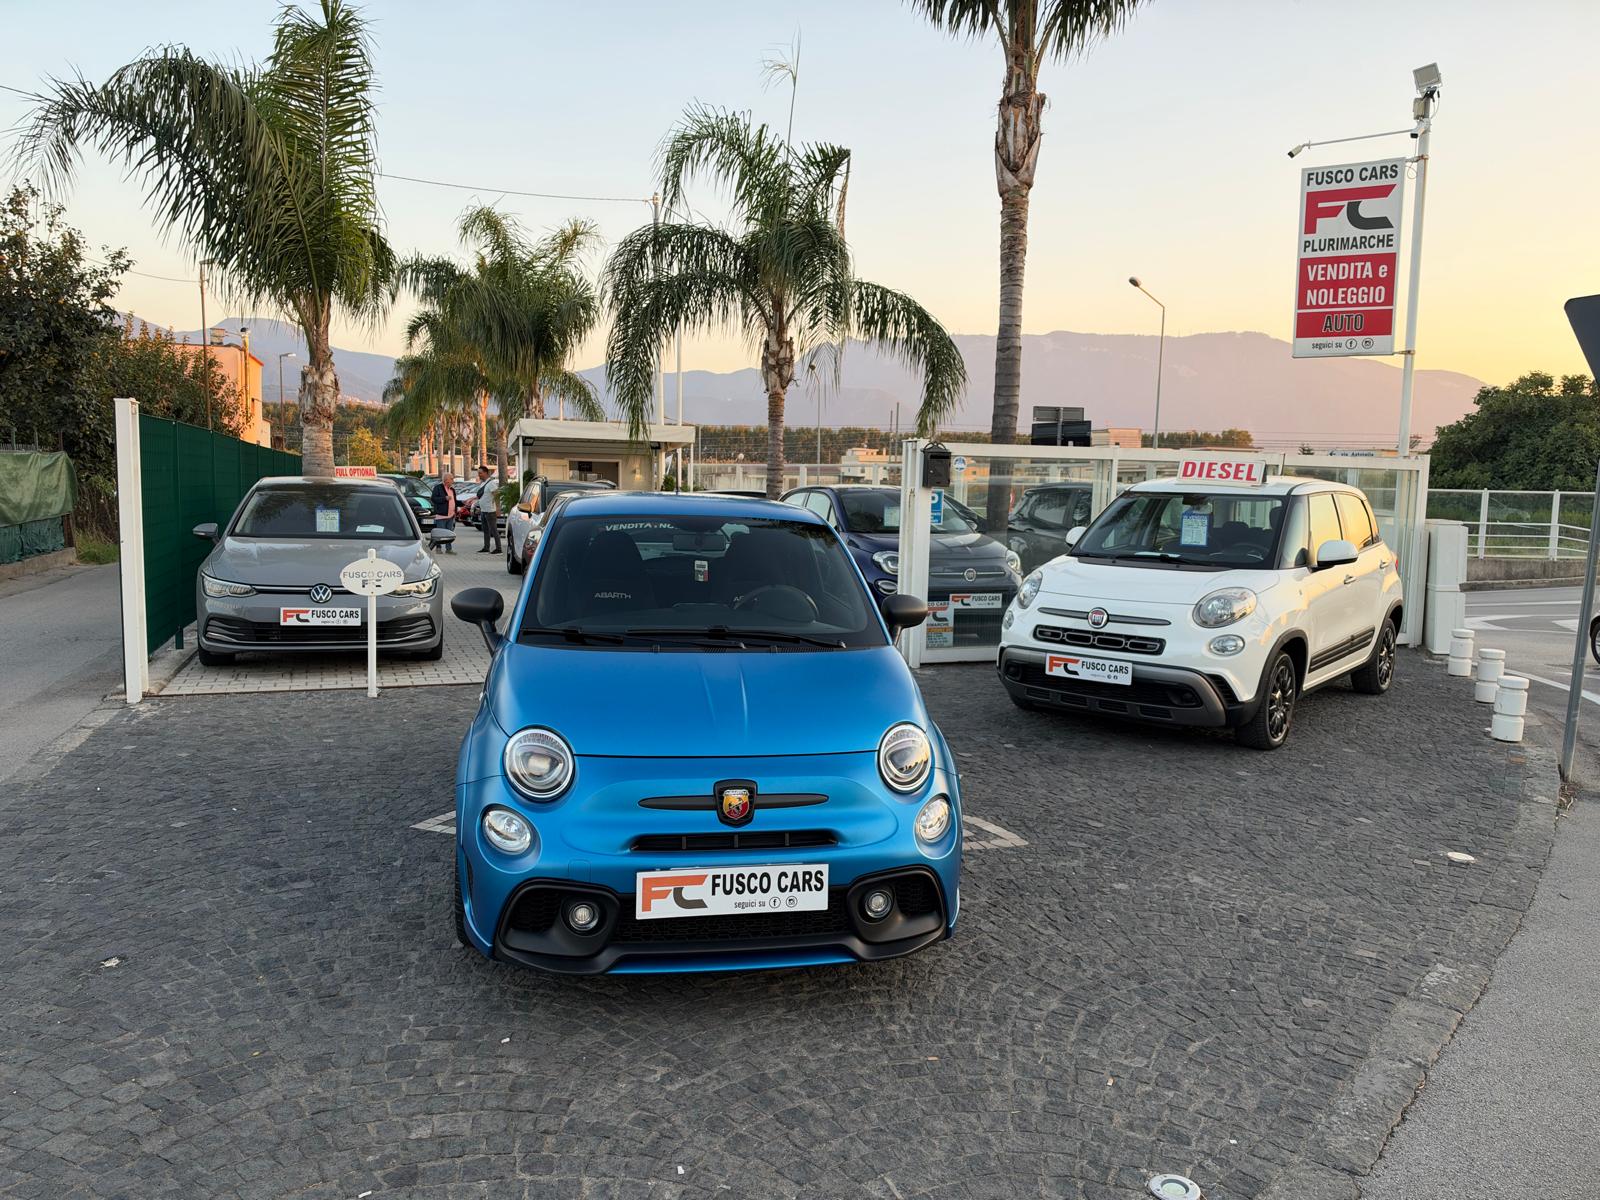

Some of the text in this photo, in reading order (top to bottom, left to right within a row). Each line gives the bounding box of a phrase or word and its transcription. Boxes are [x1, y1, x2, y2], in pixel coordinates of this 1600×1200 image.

[1307, 164, 1398, 186] FUSCO CARS
[1304, 184, 1397, 234] FC
[1303, 234, 1394, 252] PLURIMARCHE
[1307, 261, 1388, 281] VENDITA e
[1306, 286, 1385, 306] NOLEGGIO
[1322, 313, 1364, 332] AUTO
[1311, 342, 1333, 350] seguici
[335, 467, 376, 477] FULL OPTIONAL
[1182, 461, 1257, 481] DIESEL
[605, 522, 652, 531] VENDITA
[377, 570, 402, 578] CARS
[594, 591, 631, 599] ABARTH
[282, 609, 310, 622] FC
[311, 609, 359, 618] FUSCO CARS
[1048, 655, 1080, 676] FC
[1081, 661, 1129, 675] FUSCO CARS
[711, 870, 824, 896] FUSCO CARS
[642, 874, 708, 912] FC
[734, 900, 757, 910] seguici
